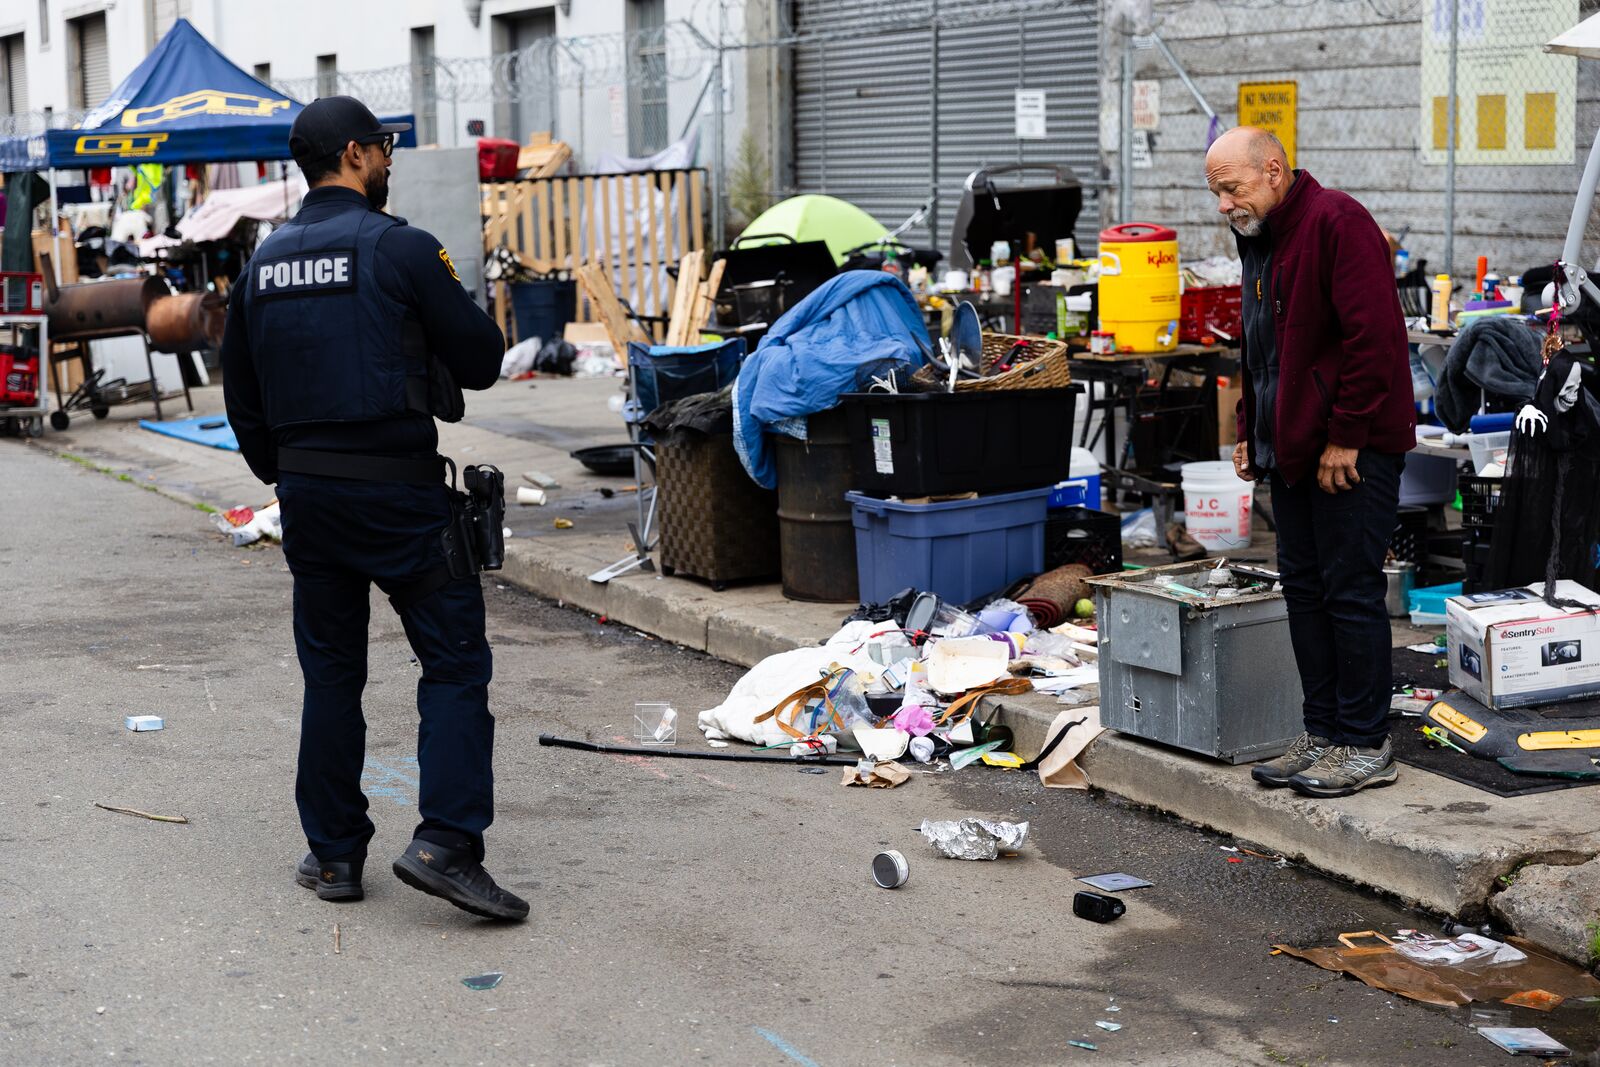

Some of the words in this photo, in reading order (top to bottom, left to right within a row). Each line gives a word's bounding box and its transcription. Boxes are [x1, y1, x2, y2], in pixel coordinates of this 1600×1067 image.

[1147, 250, 1175, 269] igloo
[259, 257, 348, 290] POLICE
[1507, 625, 1555, 639] SentrySafe
